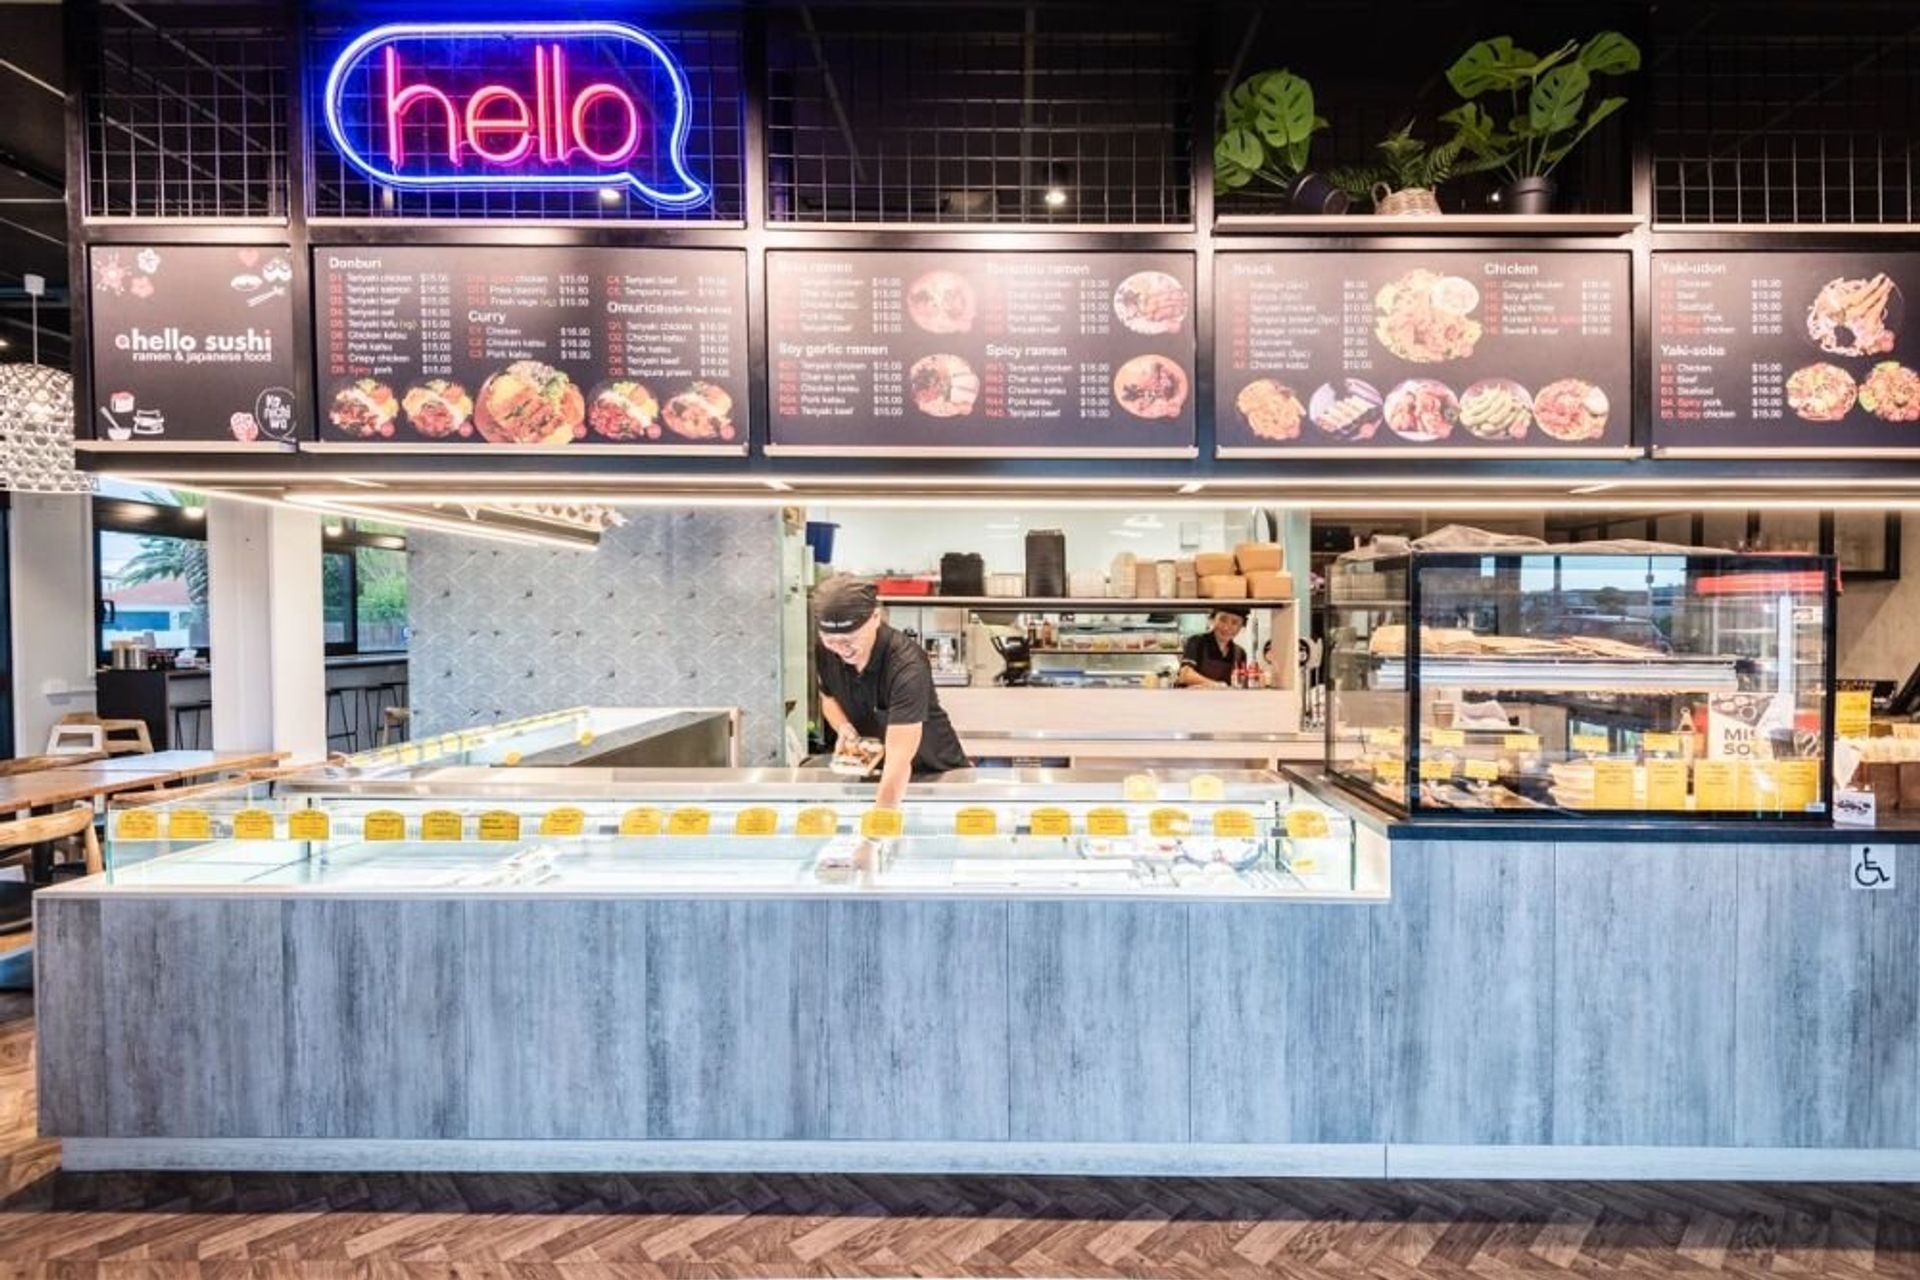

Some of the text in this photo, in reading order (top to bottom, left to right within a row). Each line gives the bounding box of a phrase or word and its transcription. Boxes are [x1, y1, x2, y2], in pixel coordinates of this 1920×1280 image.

[386, 44, 640, 166] hello
[329, 258, 382, 269] Donburi
[1484, 261, 1539, 275] Chicken
[468, 310, 505, 324] Curry
[204, 328, 273, 350] sushi
[806, 343, 843, 357] garlic
[846, 345, 888, 355] ramen
[986, 344, 1067, 358] Spicy ramen
[1660, 344, 1727, 356] Yaki-soba
[132, 351, 273, 364] ramen & japanese food
